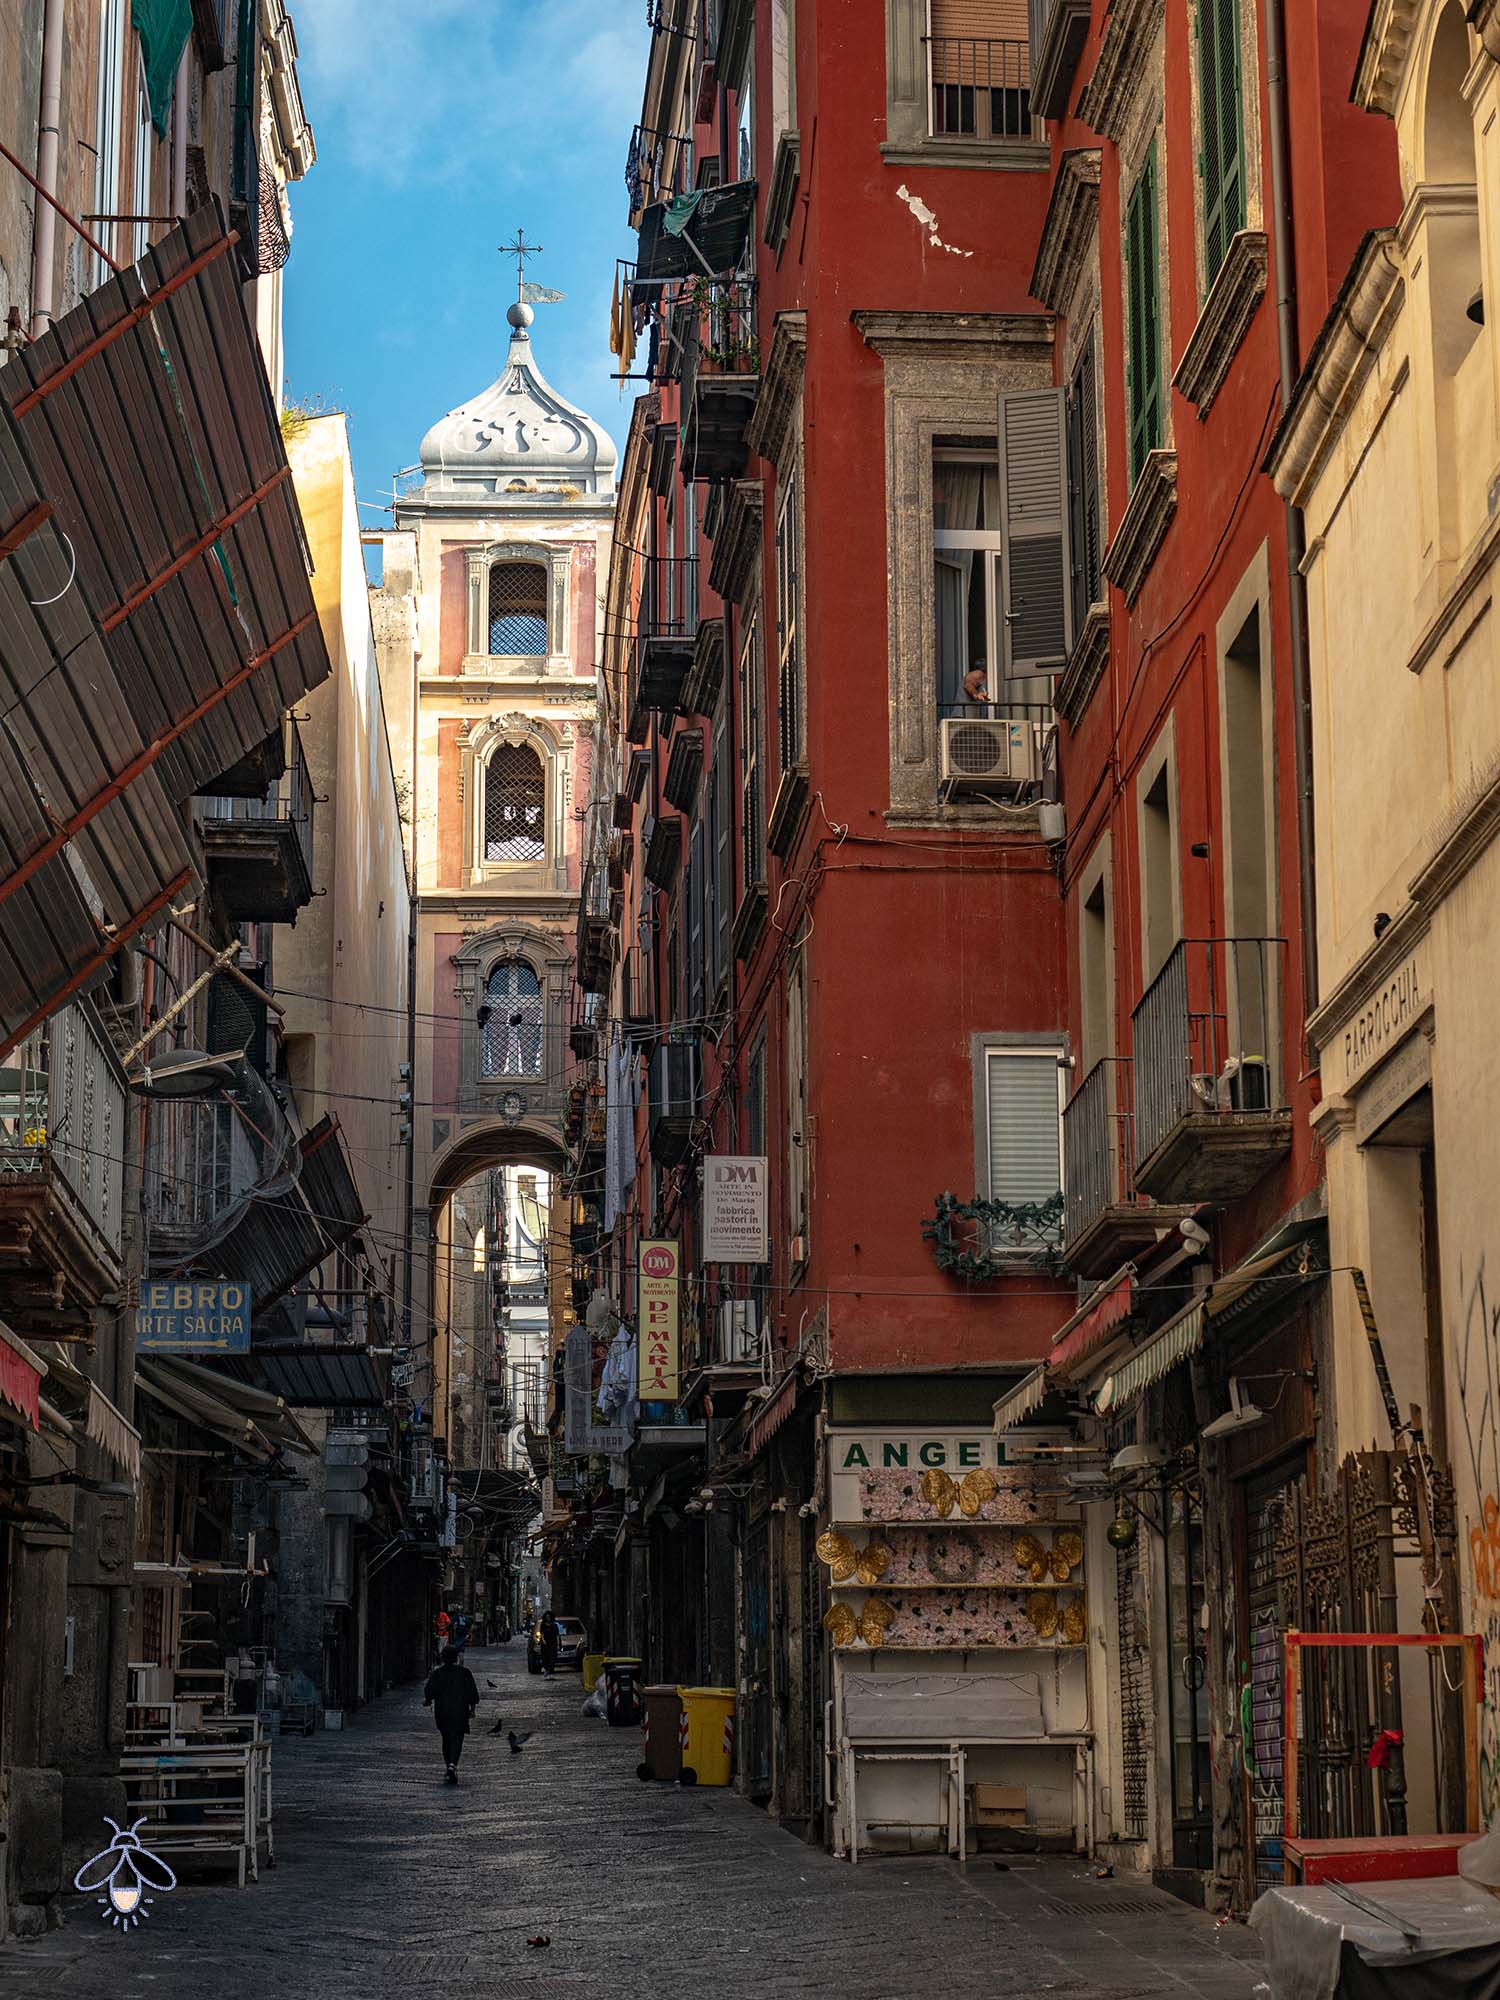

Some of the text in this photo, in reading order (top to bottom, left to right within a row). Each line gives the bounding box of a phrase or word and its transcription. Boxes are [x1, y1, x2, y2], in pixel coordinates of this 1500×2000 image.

[1345, 960, 1419, 1077] PARROCCHIA
[716, 1205, 755, 1215] fabbrica
[714, 1214, 758, 1225] pastori in
[710, 1224, 761, 1234] movimento
[647, 1256, 669, 1269] DM
[183, 1316, 244, 1334] SACRA
[647, 1301, 670, 1389] DE MARIA
